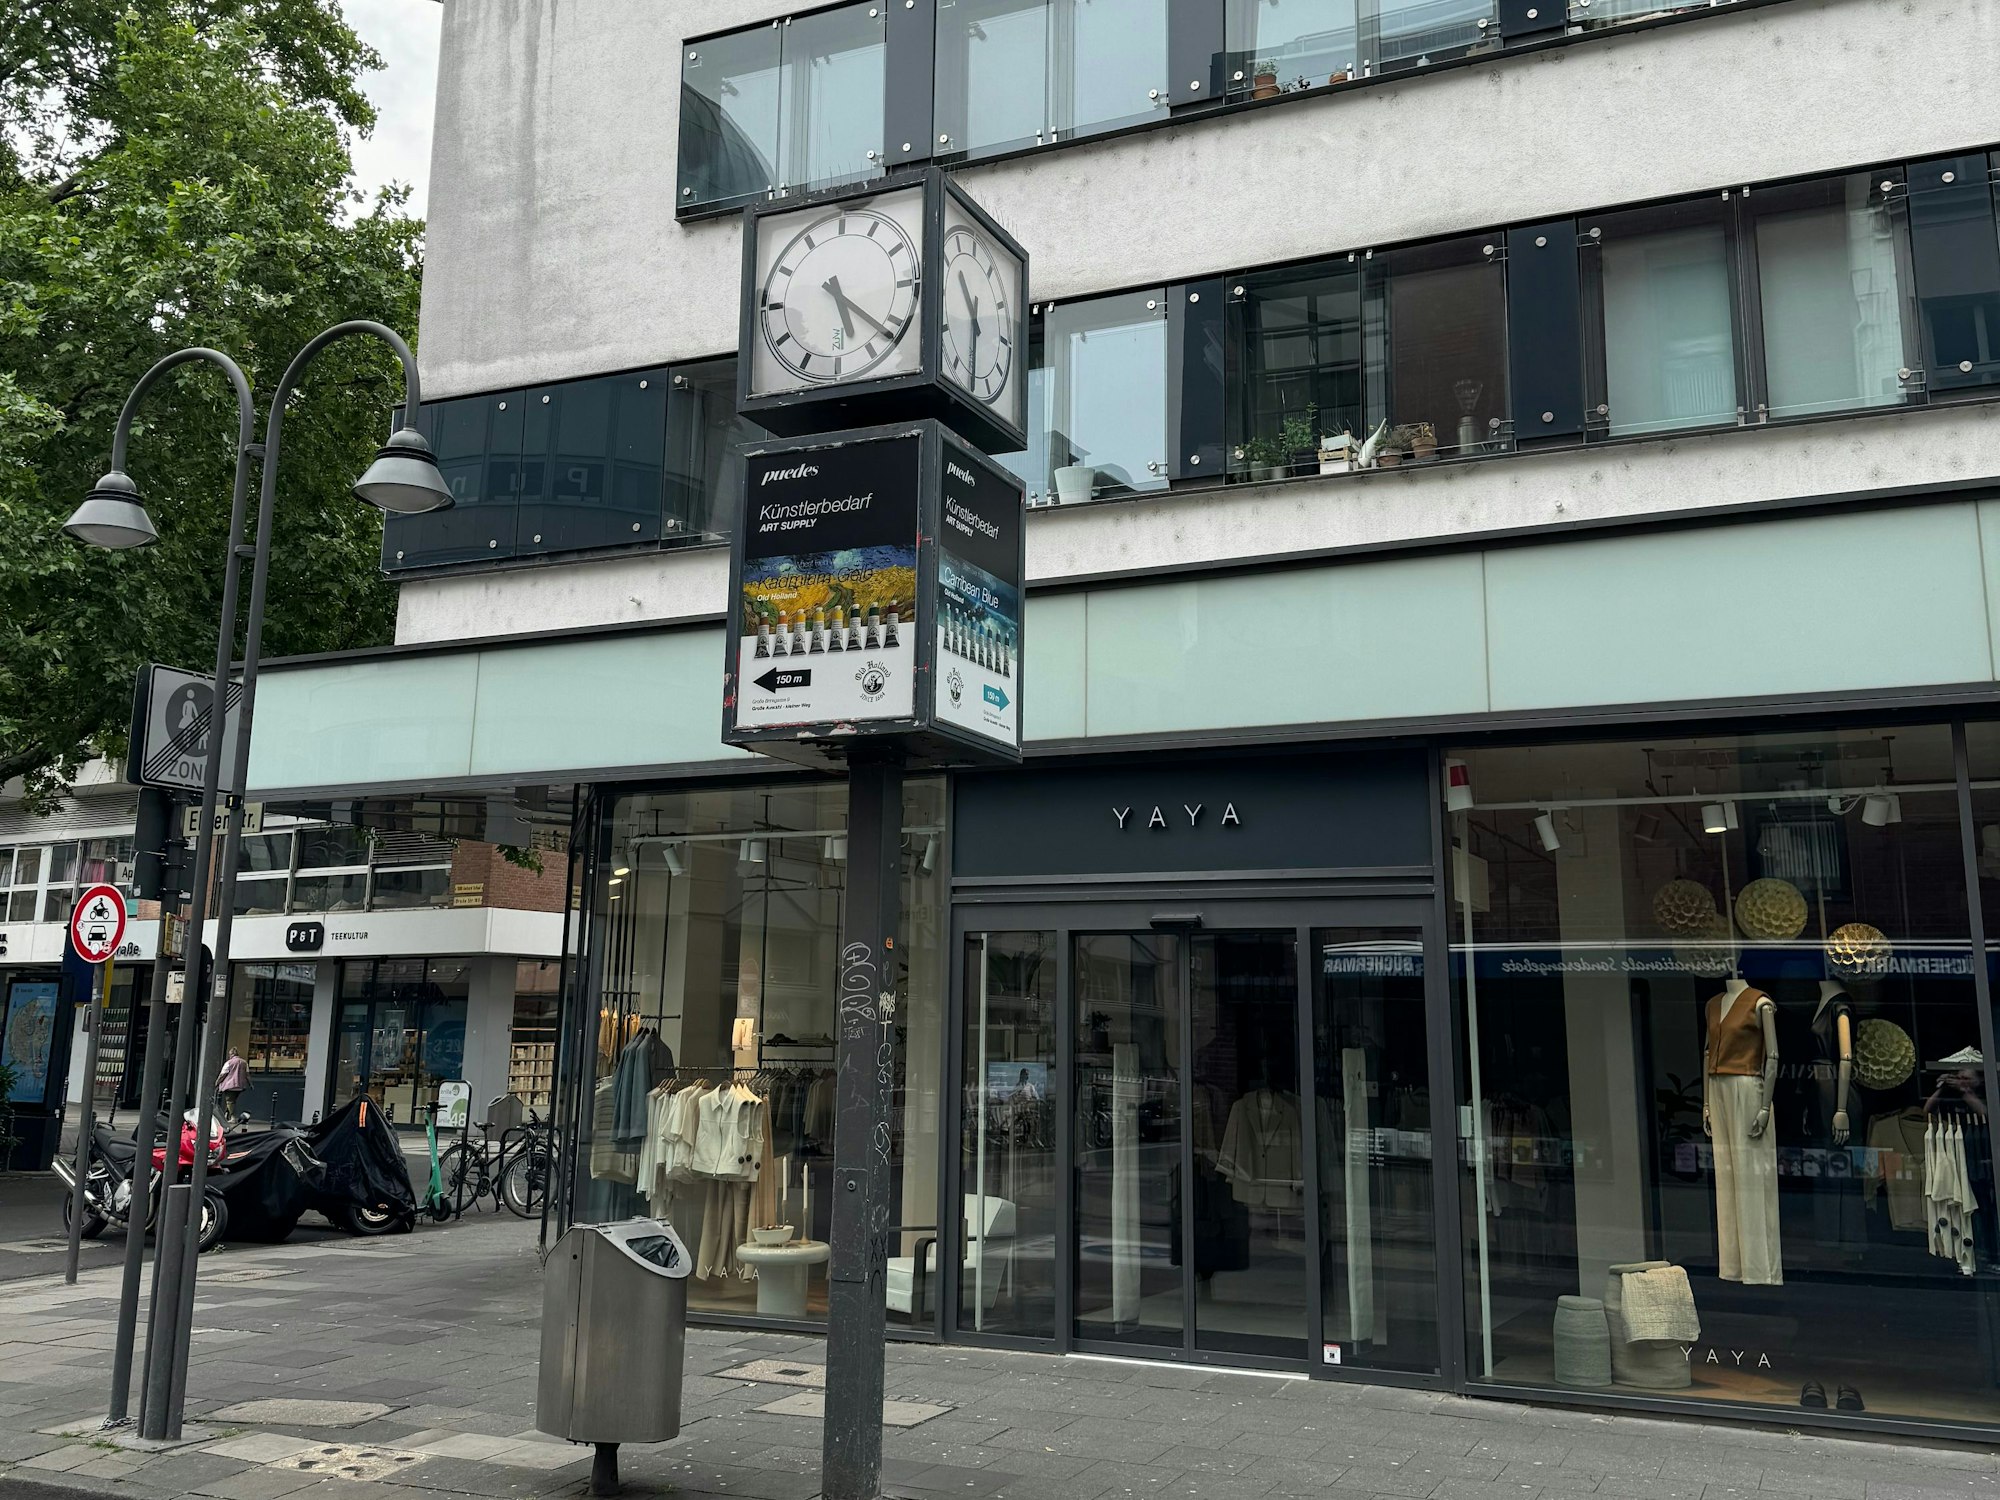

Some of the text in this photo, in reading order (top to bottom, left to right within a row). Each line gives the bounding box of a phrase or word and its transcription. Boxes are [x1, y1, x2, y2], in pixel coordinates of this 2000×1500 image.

[761, 463, 820, 486] puedes
[946, 461, 975, 488] puedes
[760, 493, 873, 521] Künstlerbedarf
[945, 495, 999, 540] Künstlerbedarf
[760, 518, 817, 532] ART SUPPLY
[945, 515, 974, 538] ART SUPPLY
[837, 565, 874, 583] Gelb
[757, 591, 798, 602] Old Holland
[981, 587, 999, 609] Blue
[776, 674, 802, 685] 150 m
[854, 659, 892, 681] Old Holland
[168, 760, 206, 783] ZON
[189, 809, 255, 832] Eentr.
[1112, 802, 1241, 830] YAYA
[331, 931, 369, 941] TEEKULTUR
[116, 941, 140, 956] raße
[704, 1265, 760, 1281] YAYA
[1680, 1345, 1772, 1369] YAYA
